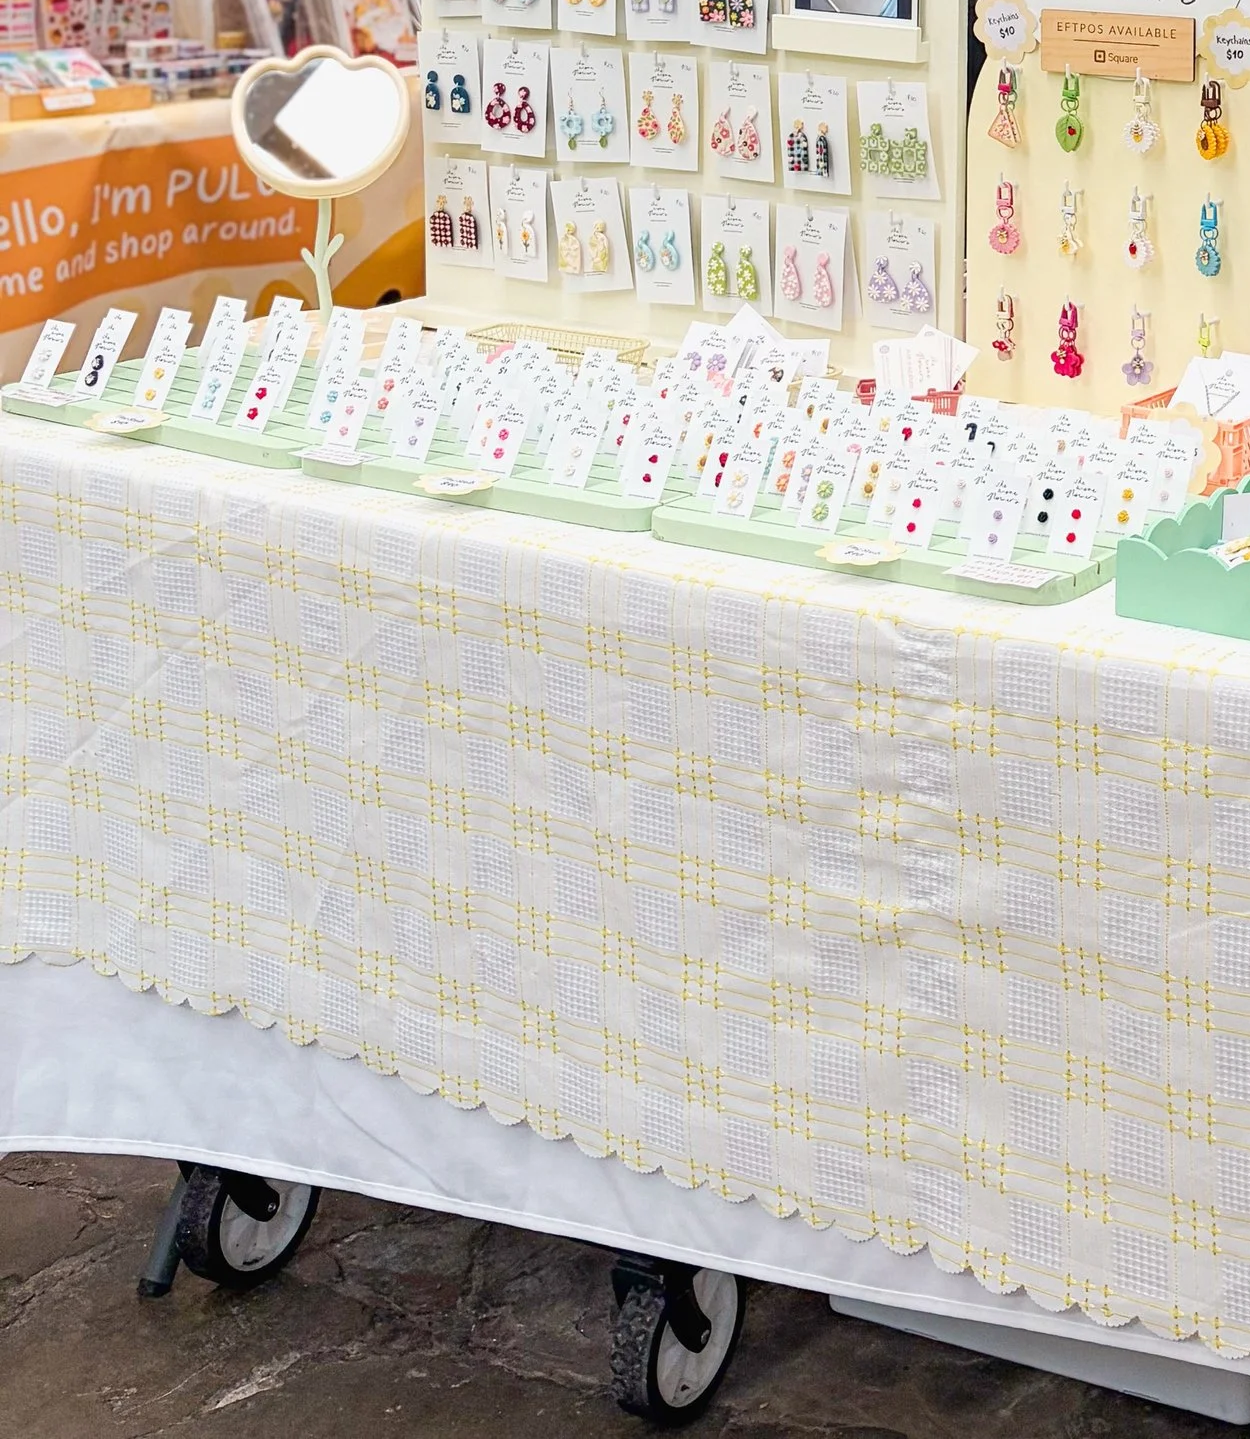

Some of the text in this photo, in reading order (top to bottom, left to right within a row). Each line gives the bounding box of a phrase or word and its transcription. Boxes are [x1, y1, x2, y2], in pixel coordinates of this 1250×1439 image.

[999, 26, 1015, 39] $10
[1056, 21, 1177, 40] EFTPOS AVAILABLE
[1108, 53, 1139, 64] Square
[1226, 49, 1244, 61] $10
[91, 183, 151, 225] I'm
[56, 240, 97, 282] and
[105, 230, 173, 265] shop
[182, 207, 301, 245] around.
